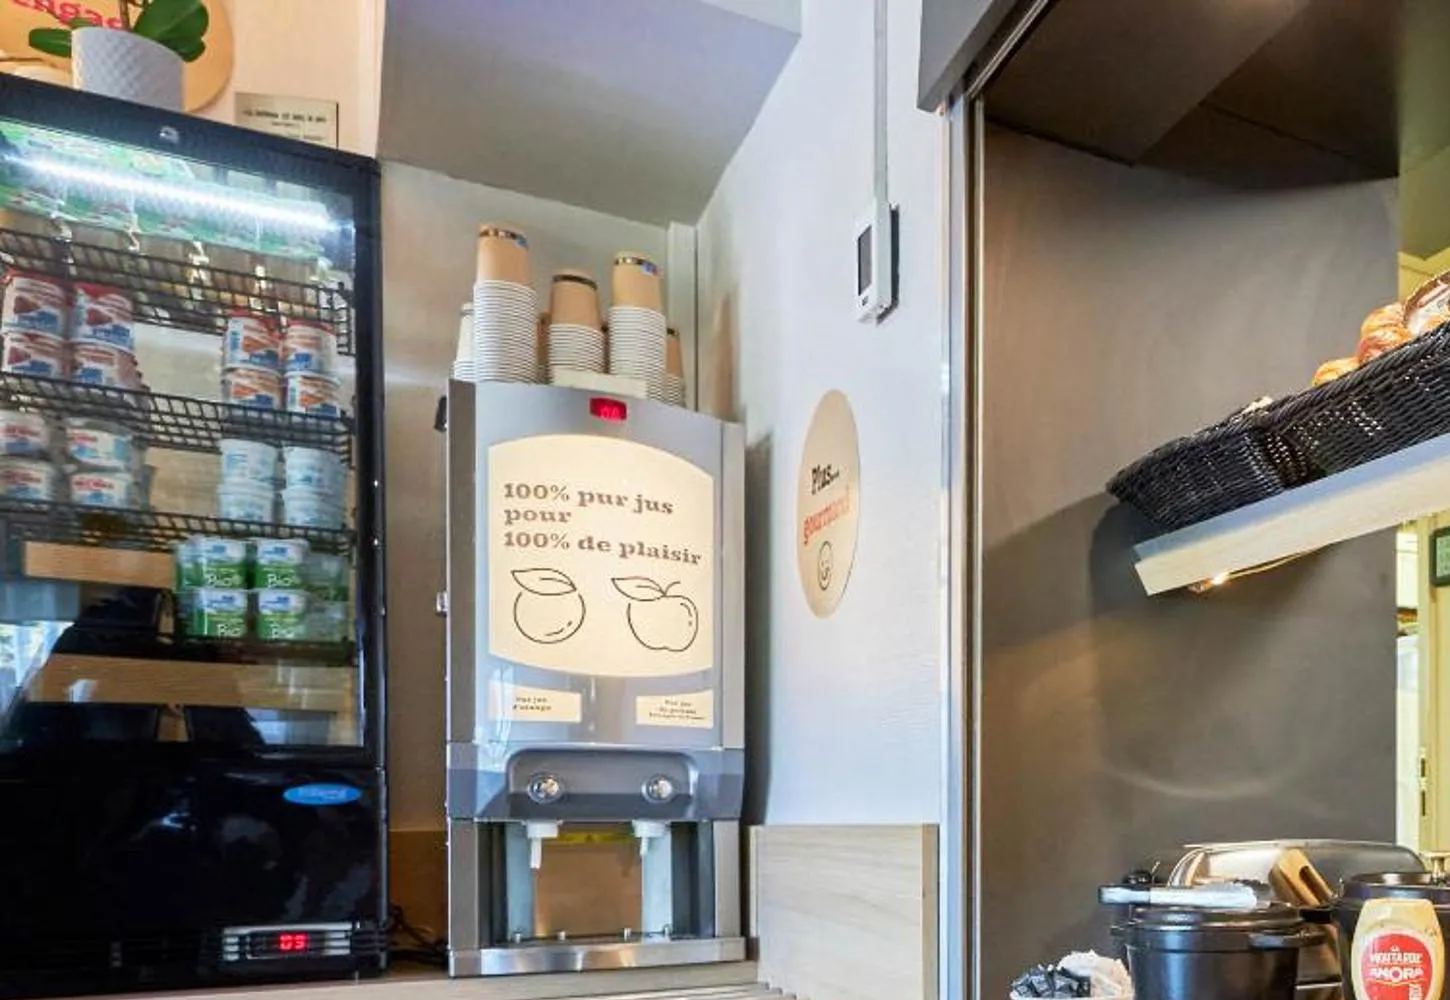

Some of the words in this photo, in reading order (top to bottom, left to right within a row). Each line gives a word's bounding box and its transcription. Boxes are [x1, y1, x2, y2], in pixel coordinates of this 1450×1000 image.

[504, 482, 570, 502] 100%
[577, 489, 629, 507] pur
[632, 494, 674, 515] jus
[504, 508, 572, 526] pour
[503, 531, 570, 550] 100%
[577, 535, 611, 552] de
[618, 541, 702, 565] plaisir
[1370, 967, 1425, 984] AMORA
